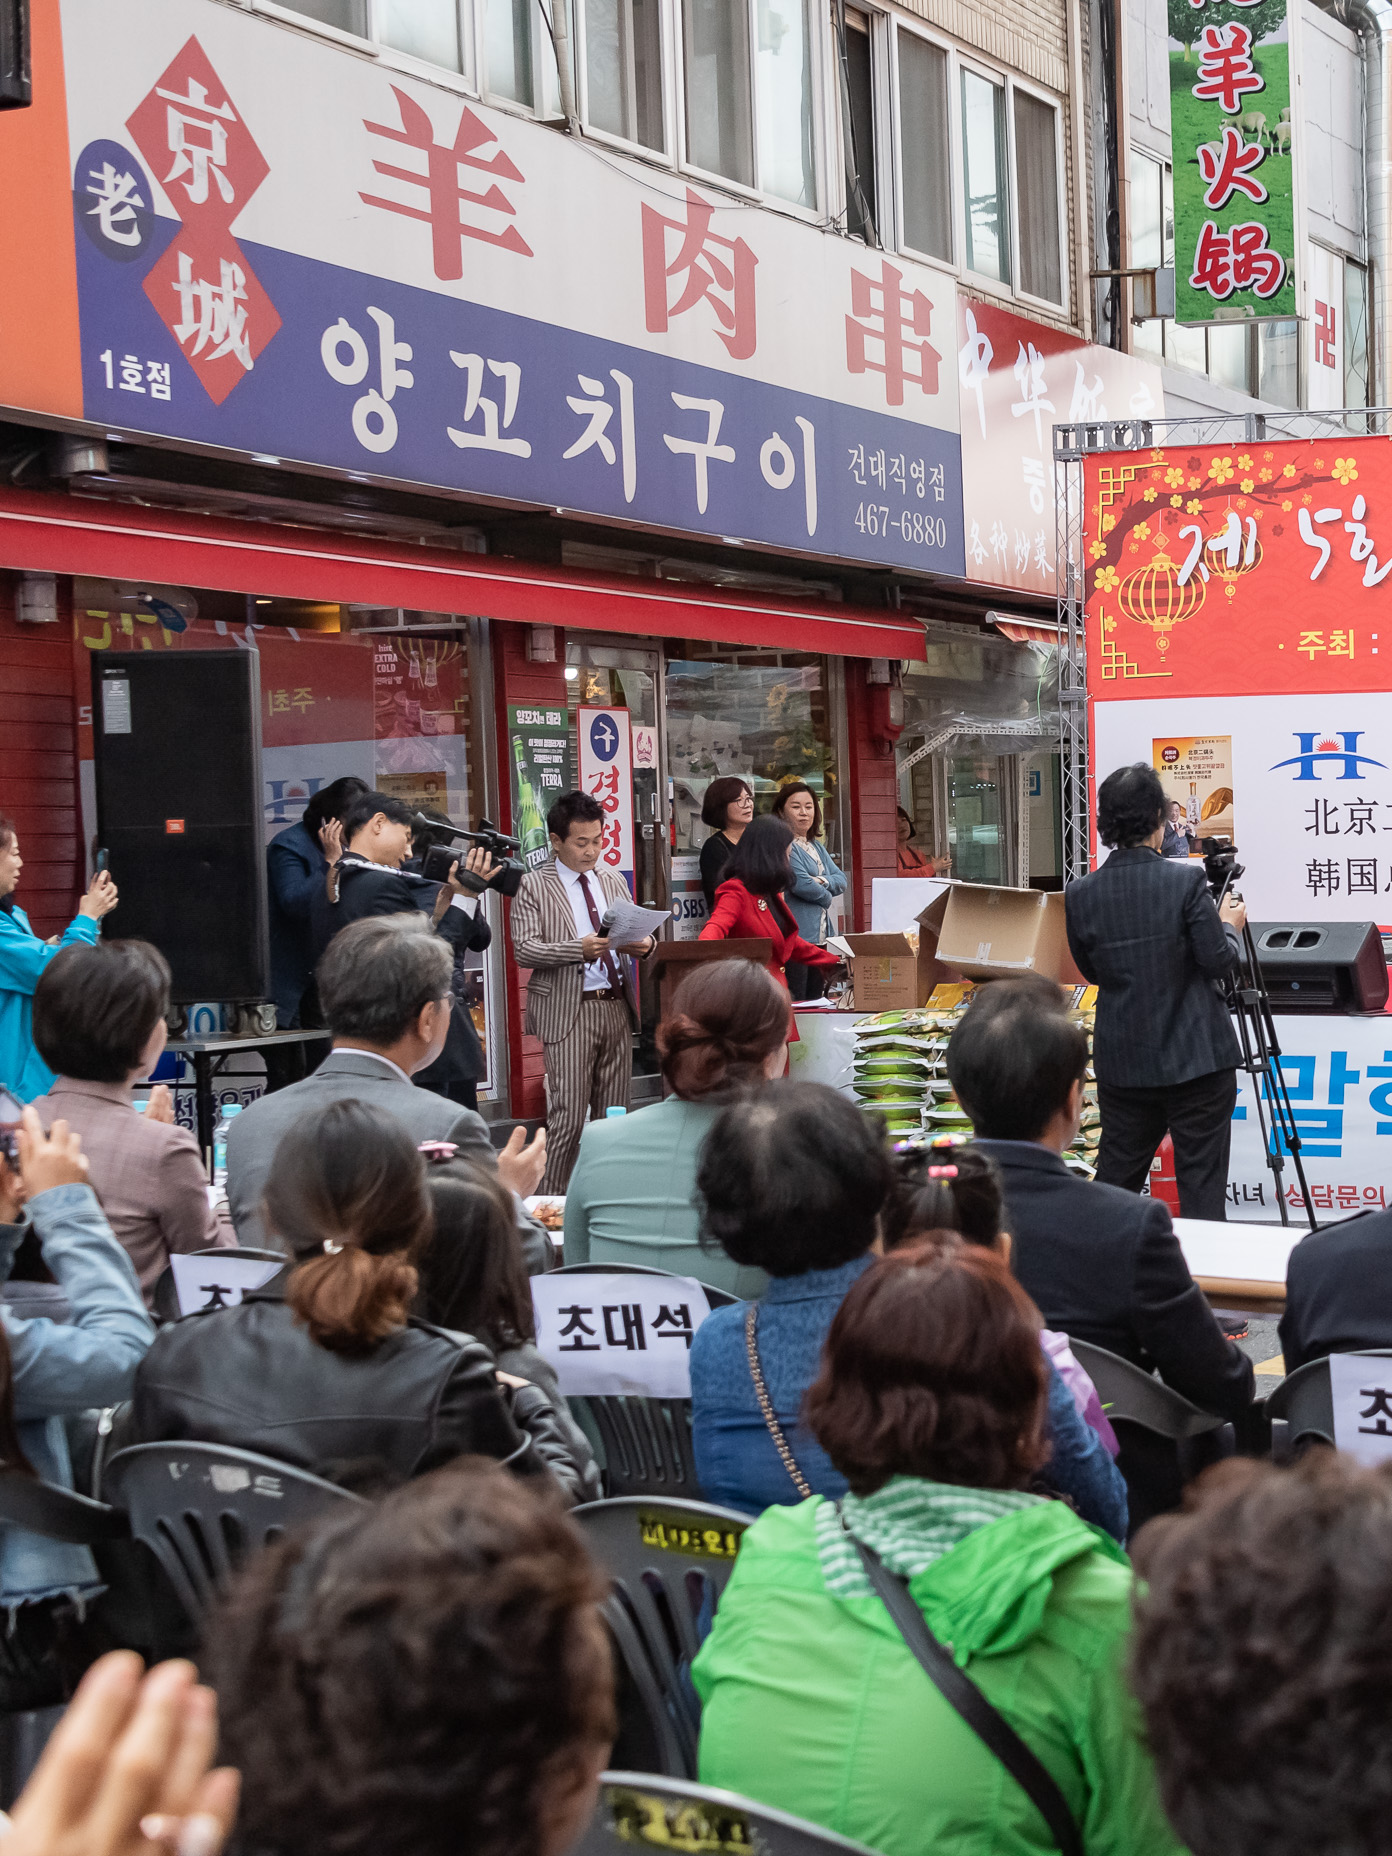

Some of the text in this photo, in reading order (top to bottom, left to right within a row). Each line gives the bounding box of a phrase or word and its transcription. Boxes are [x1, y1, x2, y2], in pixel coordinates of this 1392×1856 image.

[1189, 0, 1286, 299] 羊火锅
[86, 161, 143, 247] 老
[156, 77, 255, 371] 京城
[357, 83, 942, 407] 羊肉串
[99, 349, 173, 402] 1호점
[320, 305, 819, 537] 양꼬치구이
[847, 441, 946, 505] 건대직영점
[853, 501, 947, 549] 467-6880
[1176, 511, 1259, 587] 제
[374, 653, 399, 663] EXTRA
[376, 663, 397, 673] COLD
[1296, 627, 1357, 660] 주최
[540, 774, 564, 788] TERRA
[683, 898, 706, 919] SBS
[557, 1303, 694, 1353] 초대석
